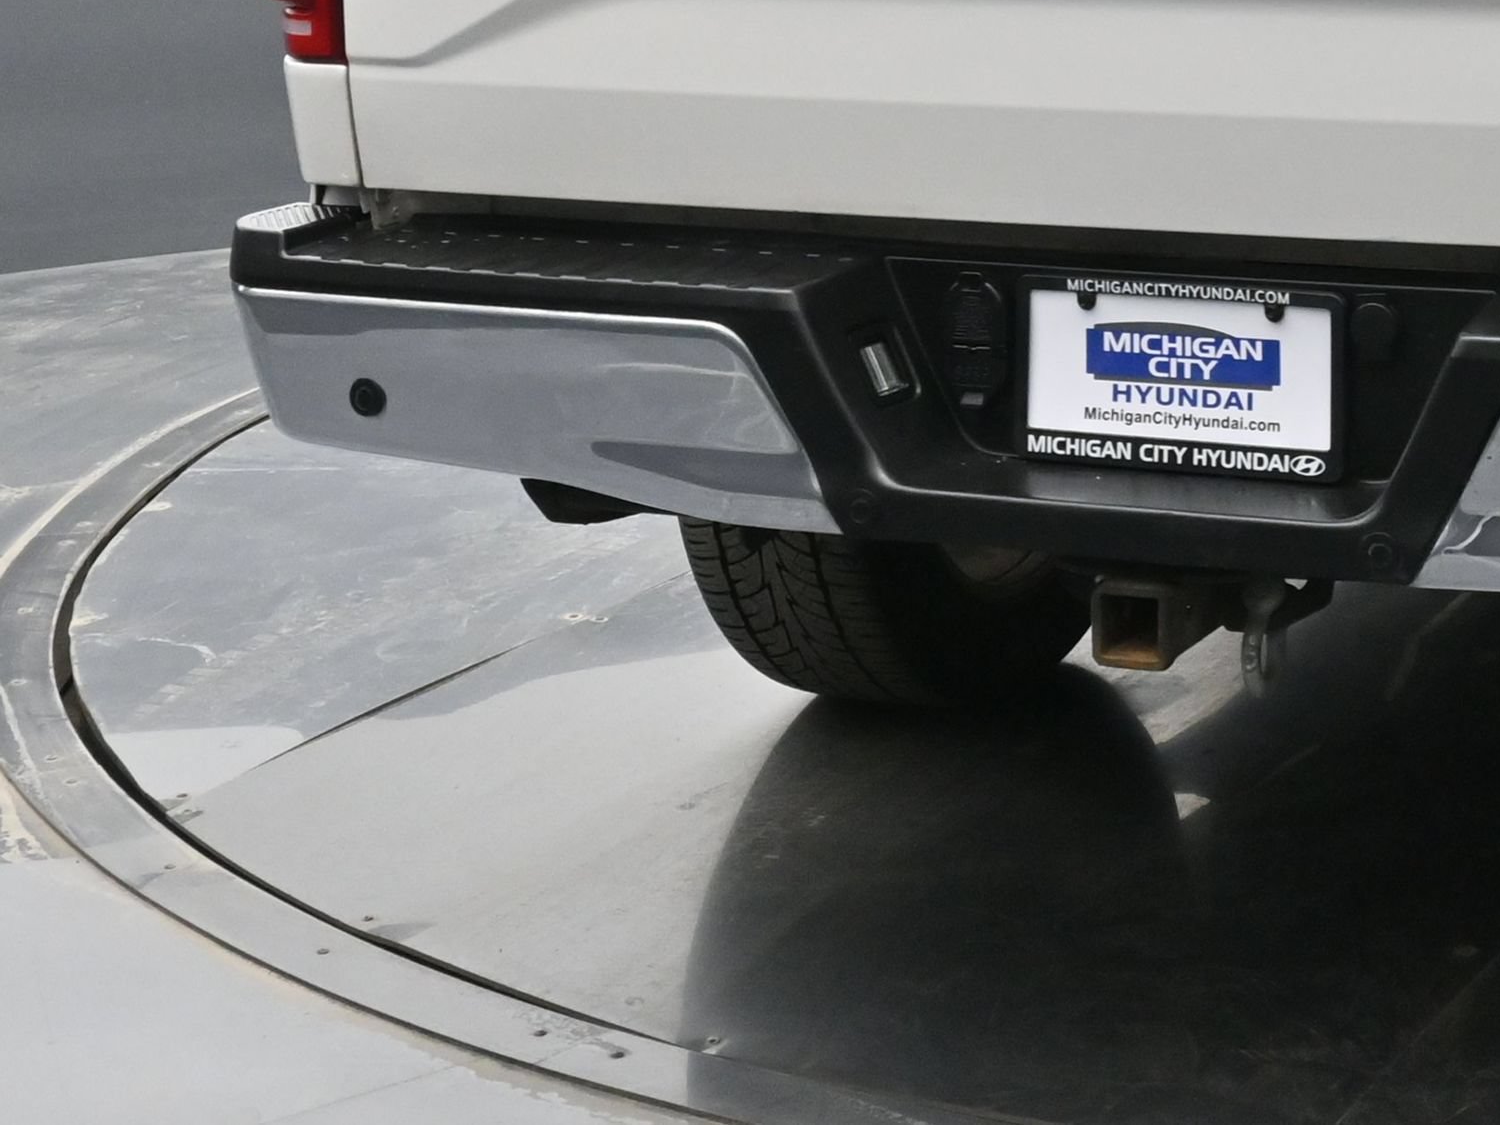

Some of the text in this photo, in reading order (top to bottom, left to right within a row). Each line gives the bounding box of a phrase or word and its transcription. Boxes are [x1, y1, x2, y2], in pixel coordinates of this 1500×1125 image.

[1066, 278, 1290, 305] MICHIGANCITYHYUNDAI.COM
[1103, 331, 1263, 361] MICHIGAN
[1148, 356, 1219, 380] CITY
[1112, 383, 1254, 411] HYUNDAI
[1084, 406, 1281, 432] MichiganCityHyundai.com
[1027, 434, 1290, 473] MICHIGAN CITY HYUNDAI
